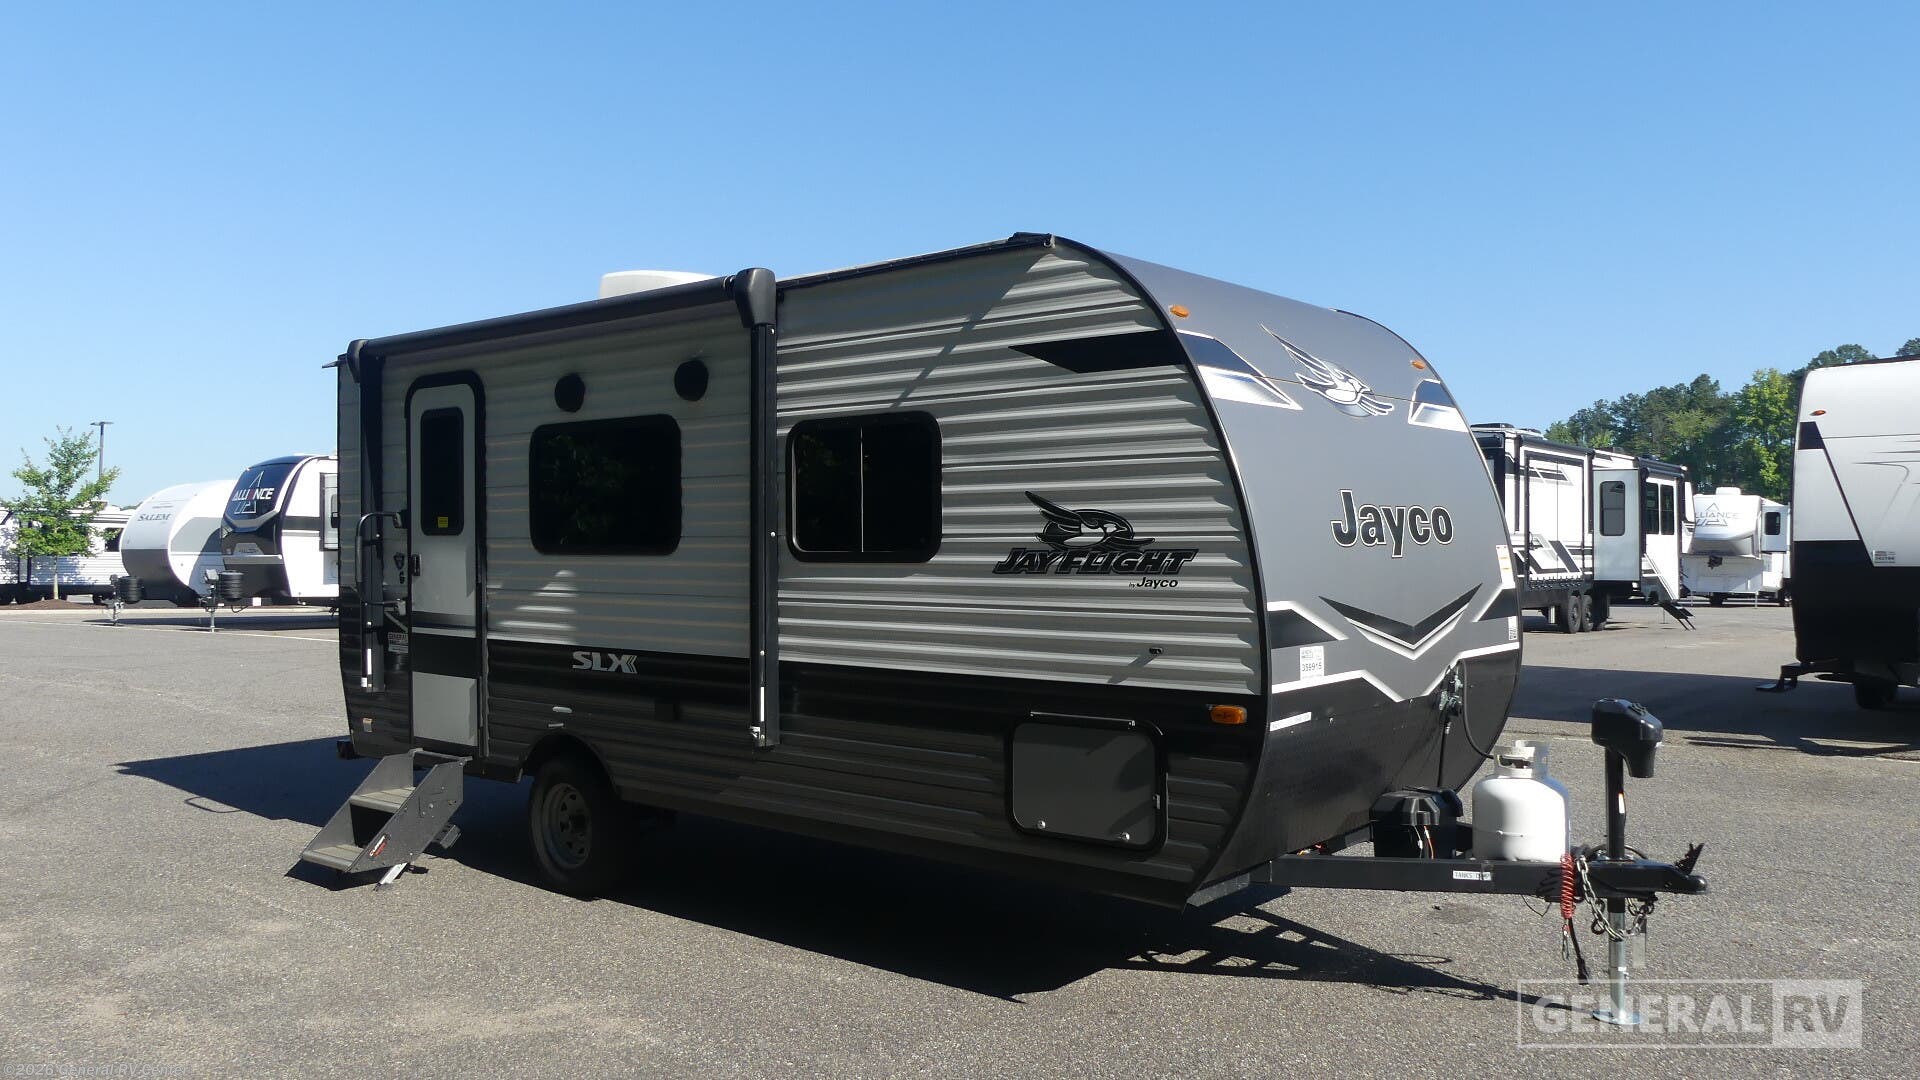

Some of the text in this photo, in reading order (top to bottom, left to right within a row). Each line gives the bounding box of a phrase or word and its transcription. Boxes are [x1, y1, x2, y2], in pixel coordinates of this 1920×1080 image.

[137, 513, 171, 522] SALEM
[1330, 488, 1454, 559] Jayco
[992, 547, 1199, 575] JAY FLIGHT
[1136, 577, 1179, 589] Jayco
[572, 651, 638, 674] SLX
